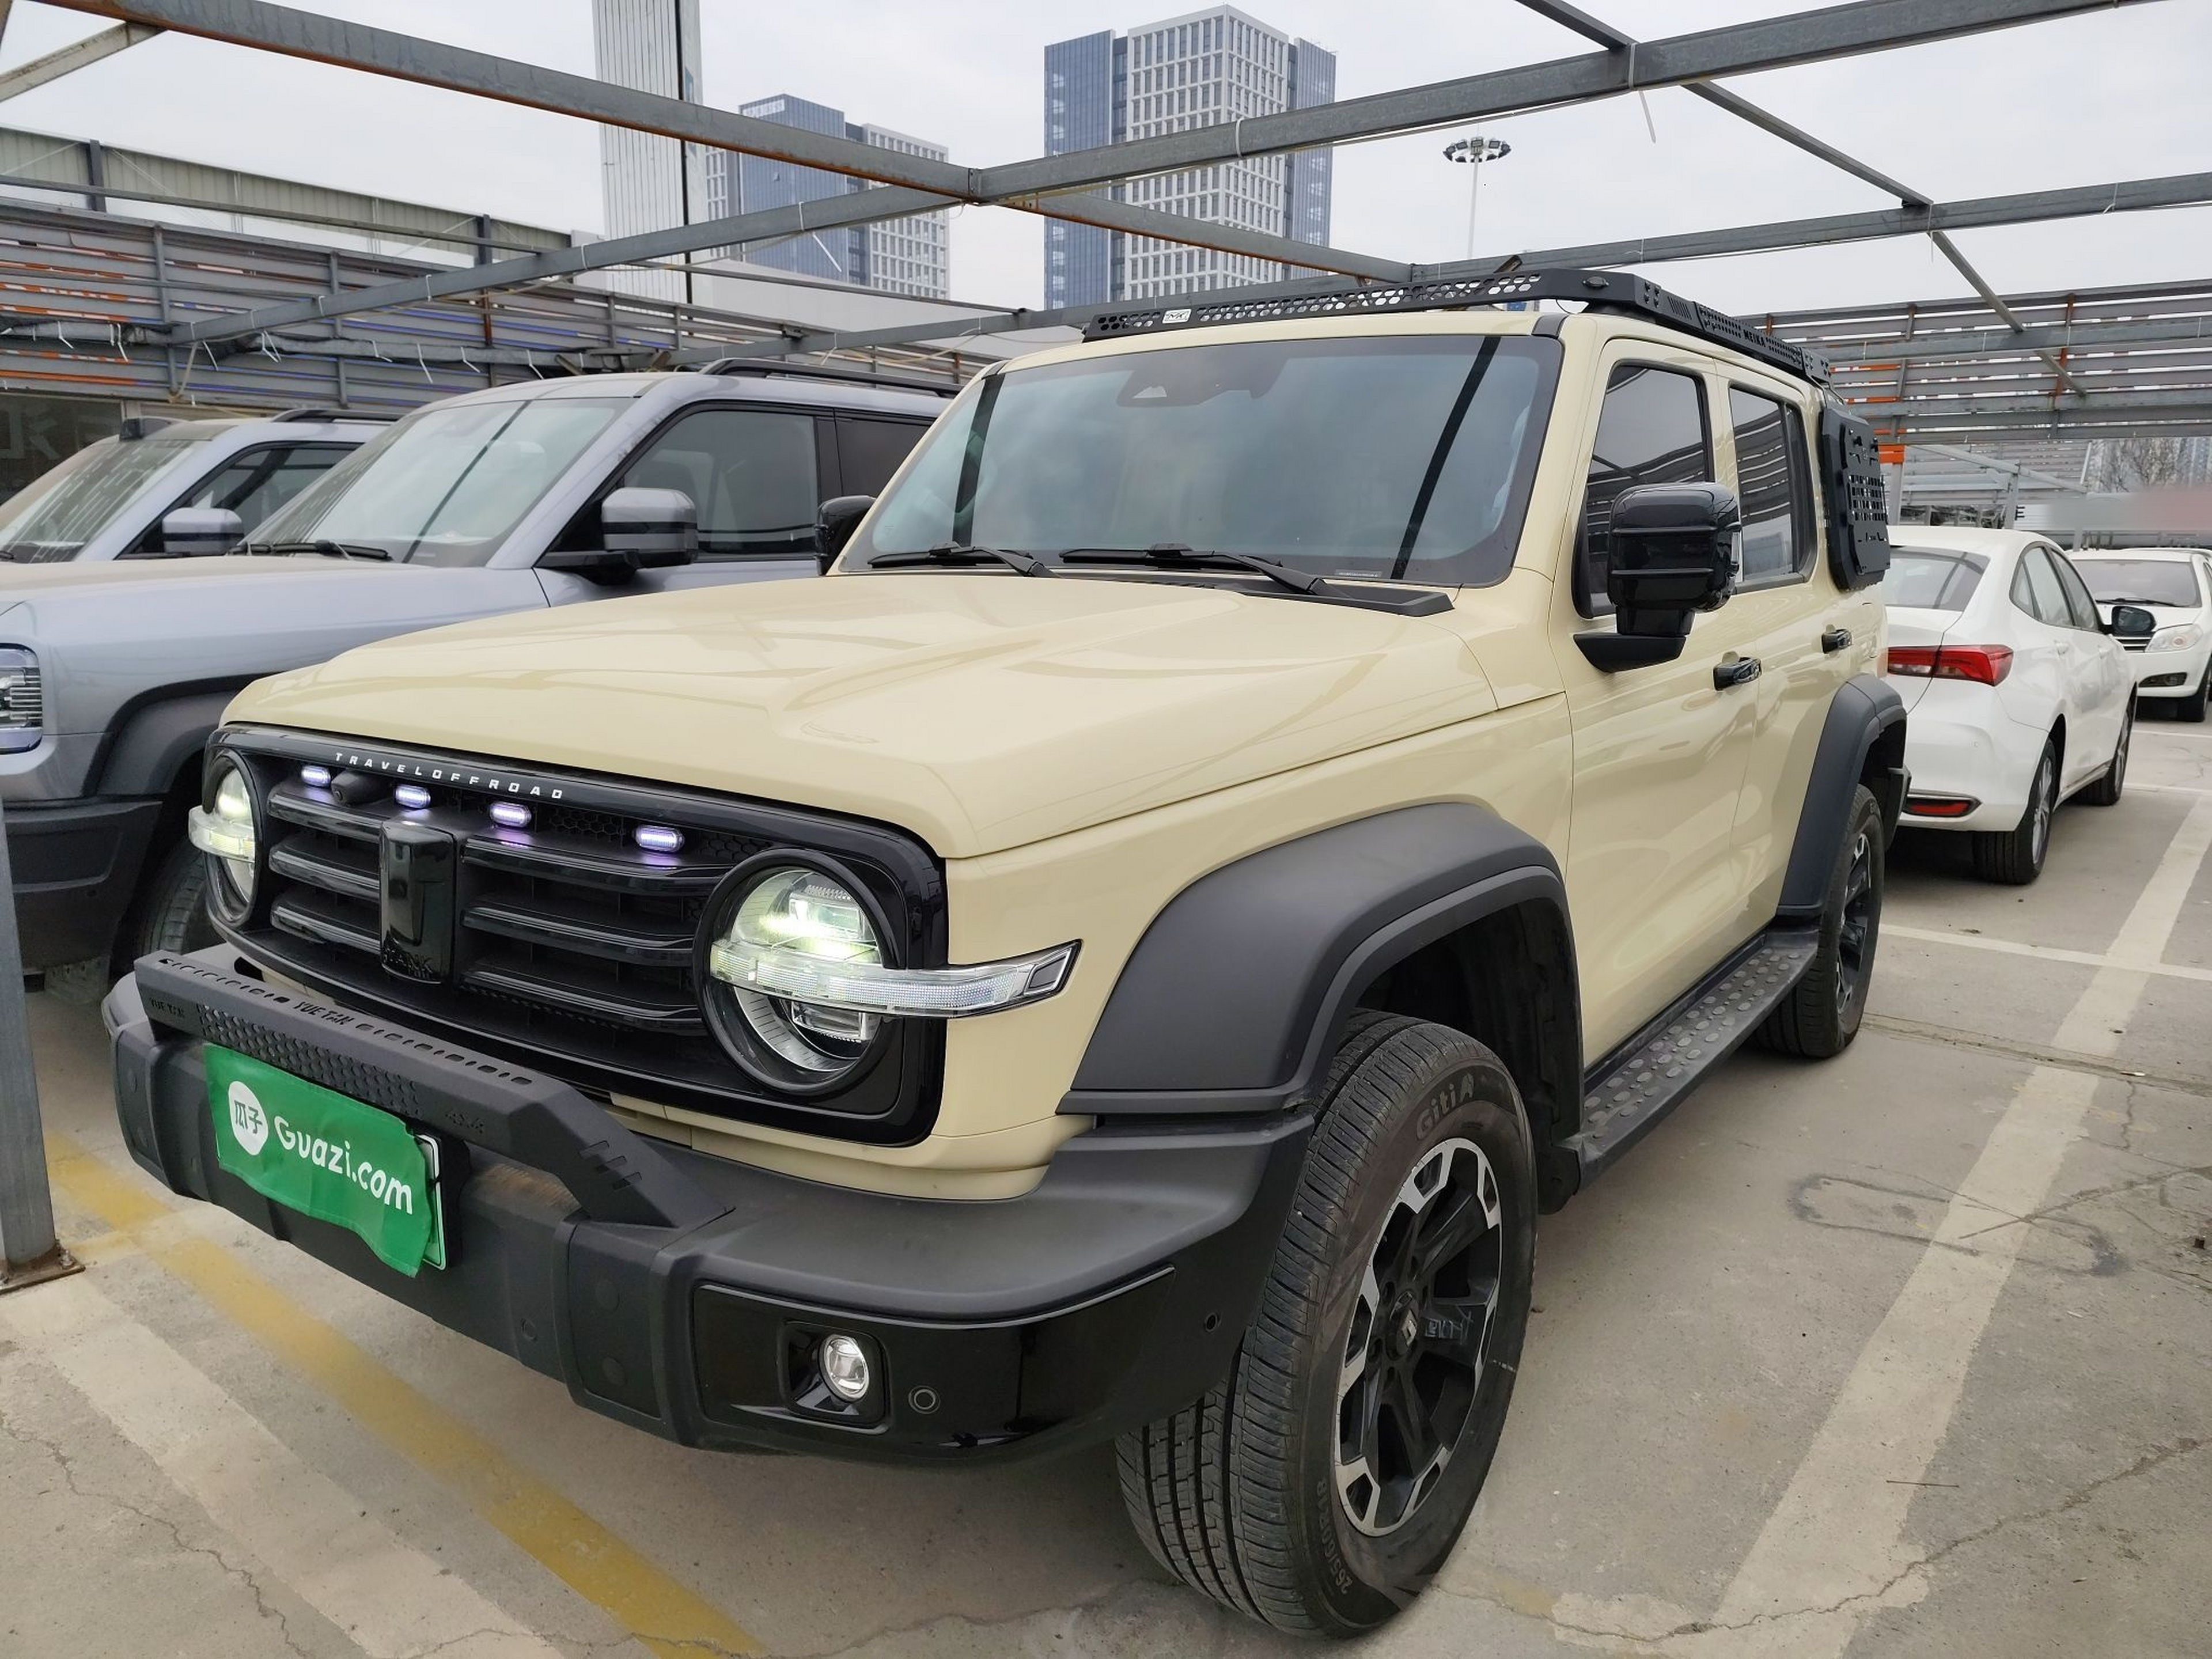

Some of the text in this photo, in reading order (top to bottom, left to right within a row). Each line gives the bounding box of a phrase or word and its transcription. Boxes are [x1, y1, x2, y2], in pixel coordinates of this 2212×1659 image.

[335, 752, 563, 800] TRAVELOFFROAD
[293, 1001, 326, 1016] YUE
[234, 1100, 263, 1135] 瓜子
[274, 1115, 413, 1215] Guazi.com
